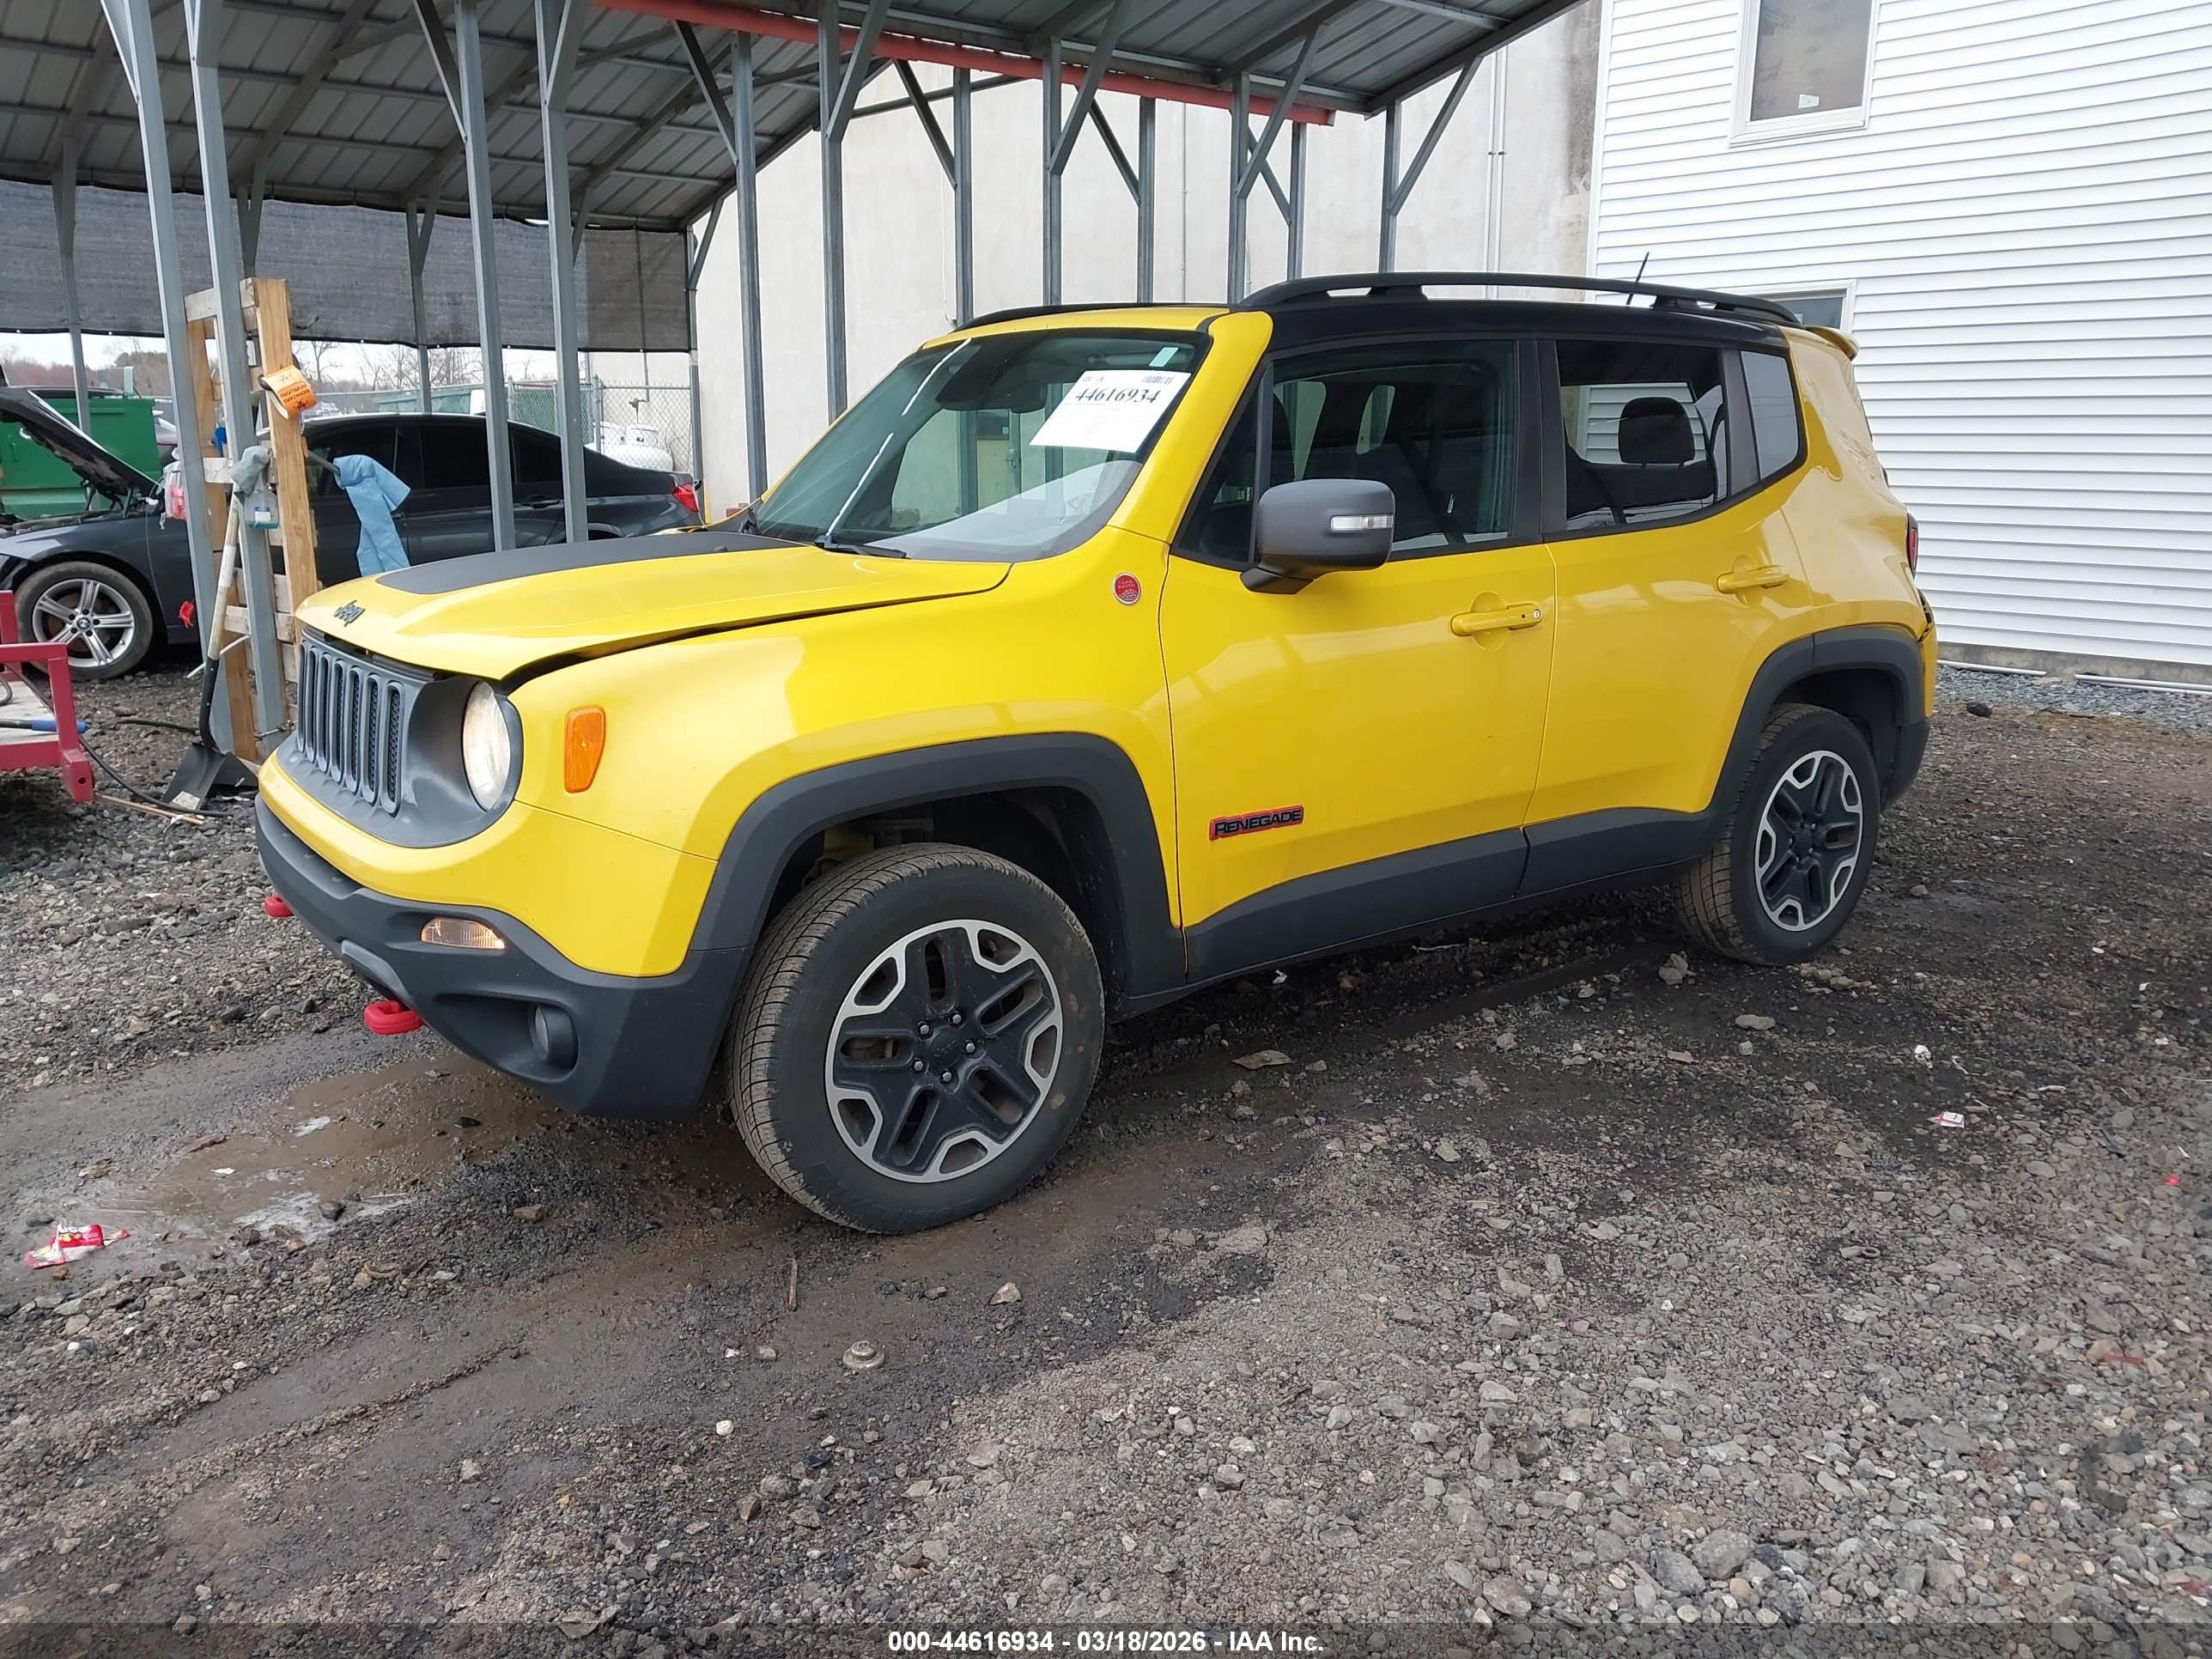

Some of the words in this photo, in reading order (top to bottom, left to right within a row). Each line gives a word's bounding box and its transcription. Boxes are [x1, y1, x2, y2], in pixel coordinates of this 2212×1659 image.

[1075, 388, 1161, 404] 44616934
[333, 599, 366, 627] Jeep
[1213, 808, 1302, 837] RENEGADE
